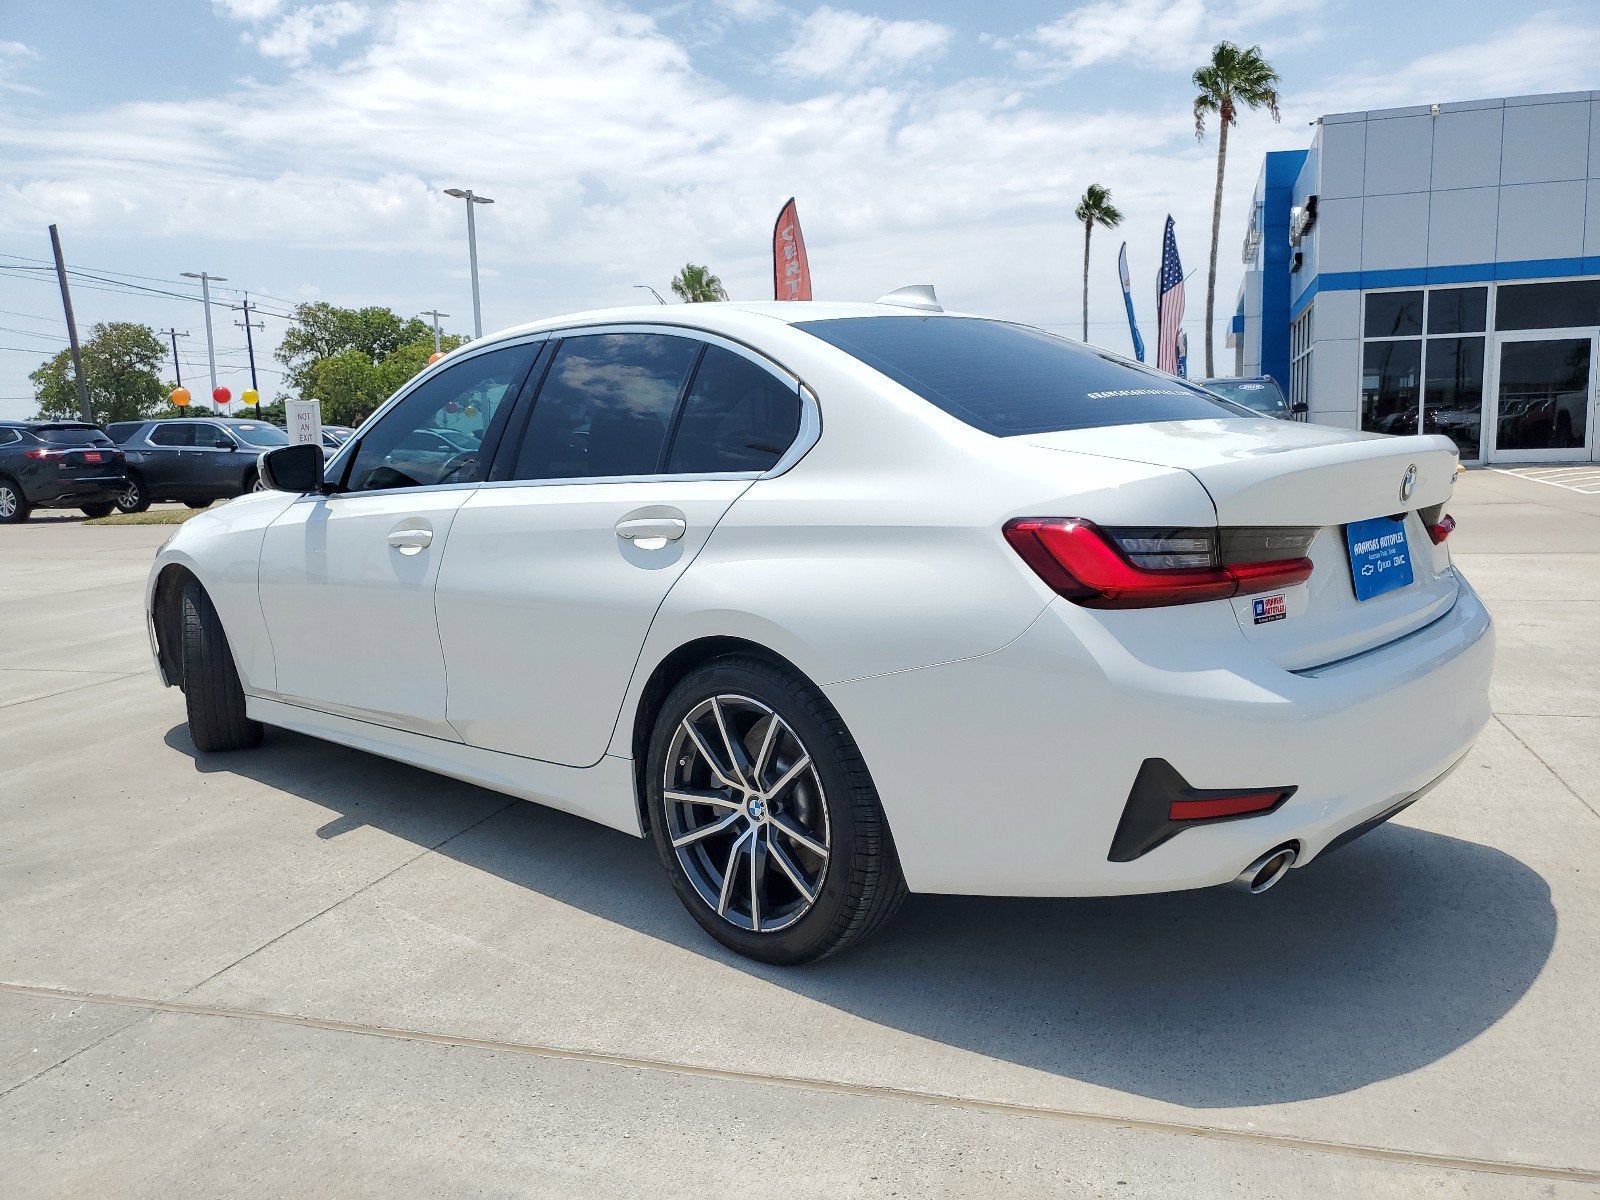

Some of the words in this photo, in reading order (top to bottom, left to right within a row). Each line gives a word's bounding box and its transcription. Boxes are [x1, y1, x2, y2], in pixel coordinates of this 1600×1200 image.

[781, 224, 801, 300] CERT
[1354, 538, 1380, 556] ARANSAS
[1380, 532, 1404, 548] AUTOPLEX
[1393, 555, 1405, 566] GMC
